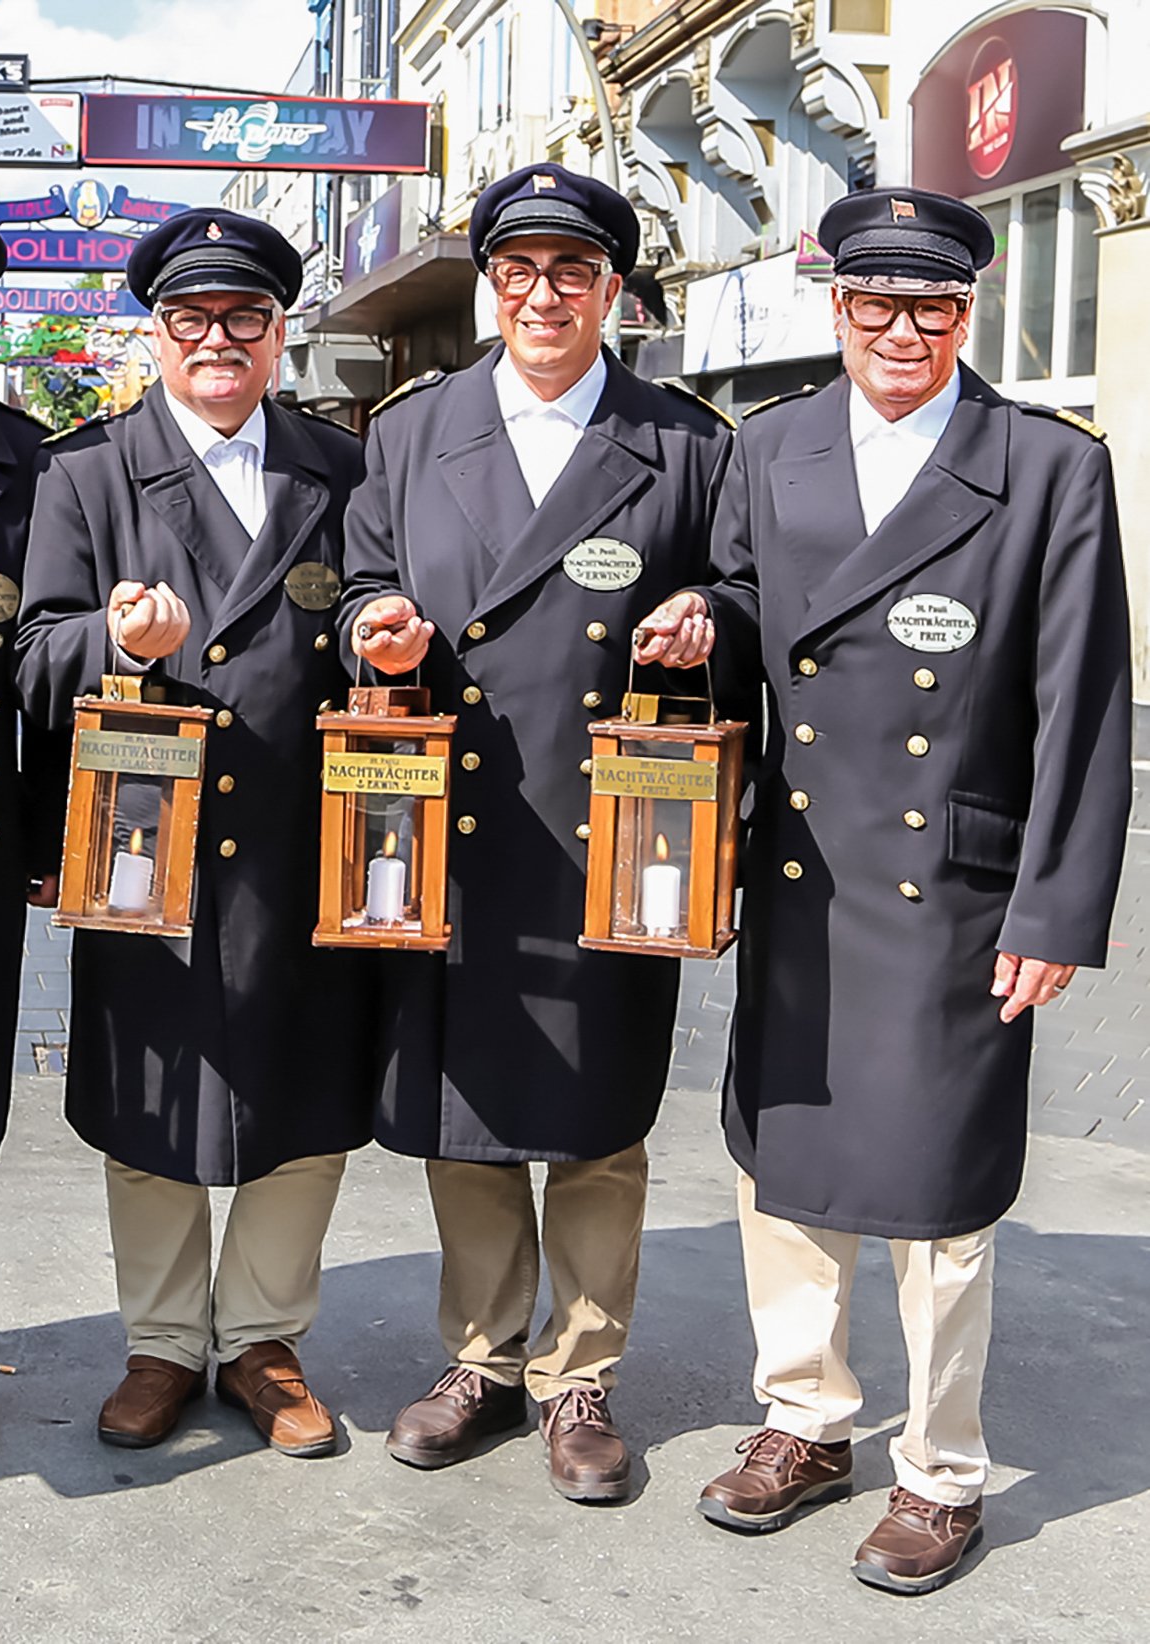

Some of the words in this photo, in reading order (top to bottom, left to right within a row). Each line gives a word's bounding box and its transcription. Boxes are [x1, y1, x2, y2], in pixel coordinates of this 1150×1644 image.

[3, 115, 24, 125] and
[136, 105, 180, 149] IN
[0, 126, 30, 137] More
[7, 199, 54, 217] TABLE
[121, 199, 169, 219] DANCE
[6, 238, 139, 261] OLLHO
[329, 765, 438, 781] NACHTWÄCHTER
